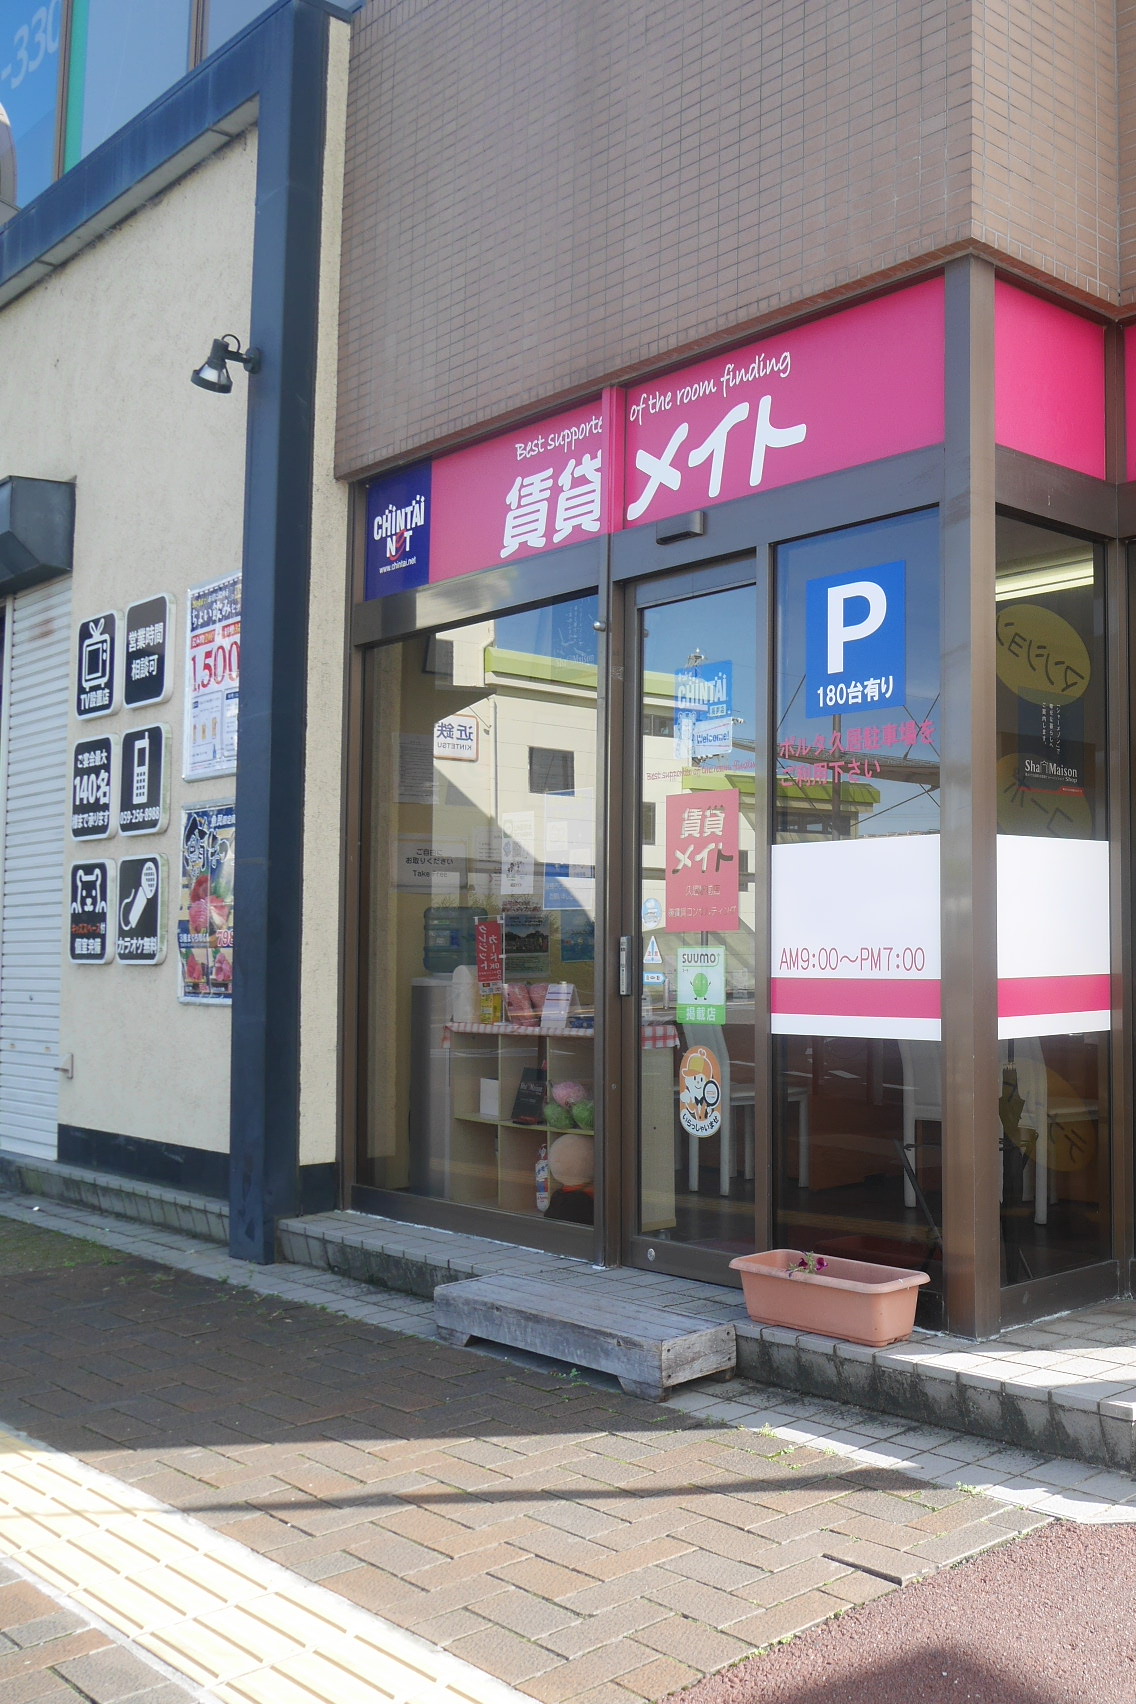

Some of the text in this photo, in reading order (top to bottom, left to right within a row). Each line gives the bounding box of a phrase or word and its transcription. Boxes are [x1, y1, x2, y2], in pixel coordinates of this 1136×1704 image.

[515, 435, 544, 461] Best
[630, 394, 648, 425] of
[650, 391, 672, 414] the
[677, 378, 717, 406] room
[721, 351, 791, 397] finding
[500, 395, 807, 558] 賃貸 メイト
[128, 622, 164, 652] 営業時間
[827, 581, 887, 675] P
[131, 654, 159, 681] 相談可
[80, 689, 110, 710] TV設置店
[817, 675, 894, 708] 180台有り
[696, 731, 730, 745] Welcome!
[780, 758, 881, 787] ご利用下さい
[74, 769, 109, 806] 140名
[680, 805, 725, 838] 賃貸
[405, 857, 454, 866] お取りください
[672, 842, 734, 875] メイト
[412, 869, 430, 878] Take
[117, 936, 158, 954] カラオケ無料
[685, 1006, 717, 1022] 掲載店
[682, 1113, 720, 1132] いらっしゃいませ
